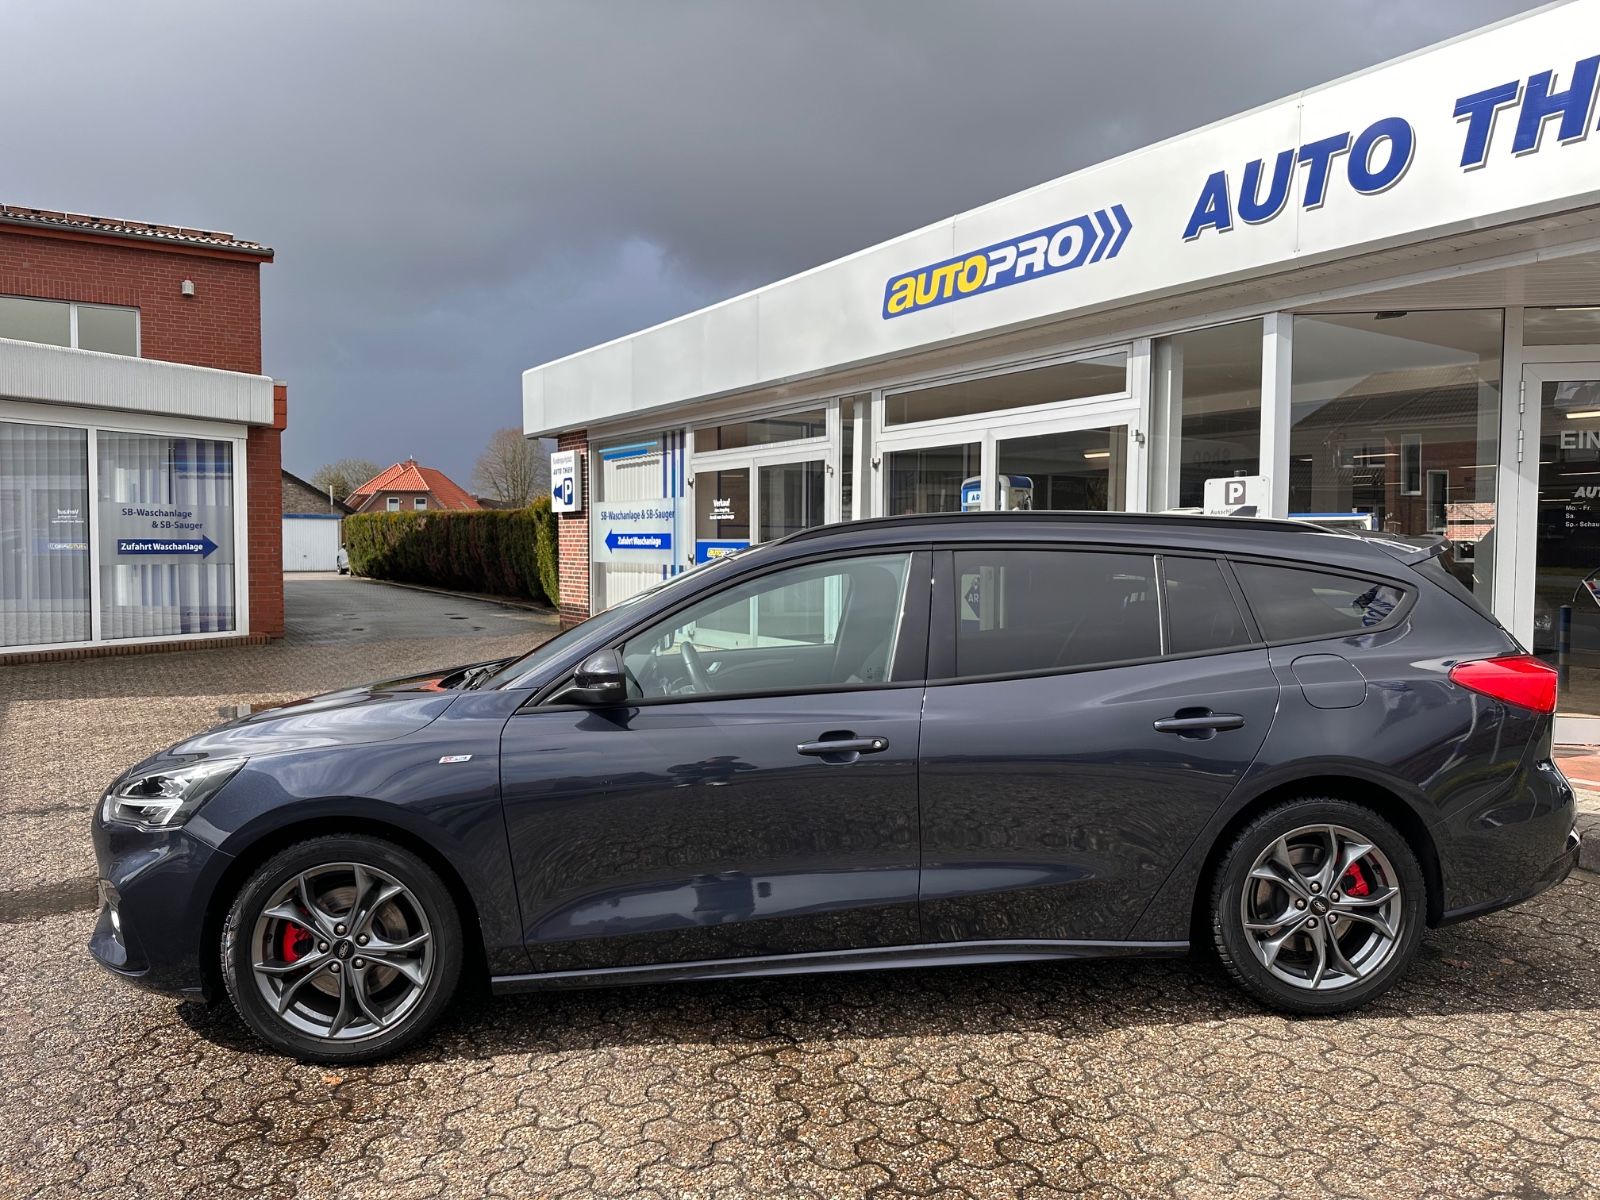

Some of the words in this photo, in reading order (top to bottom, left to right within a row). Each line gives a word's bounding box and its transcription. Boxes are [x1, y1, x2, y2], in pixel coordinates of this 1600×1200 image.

[1182, 117, 1416, 242] AUTO
[1453, 54, 1600, 172] TH
[565, 480, 572, 503] P
[1229, 483, 1244, 504] P
[122, 508, 192, 519] SB-Waschanlage
[600, 509, 640, 522] SB-Waschanlage
[641, 509, 646, 519] &
[646, 508, 675, 522] SB-Sauger
[152, 521, 158, 529] &
[160, 520, 203, 530] SB-Sauger
[121, 543, 152, 551] Zufahrt
[153, 543, 203, 552] Waschanlage
[617, 535, 633, 546] Zufahrt
[633, 535, 662, 548] Waschanlage
